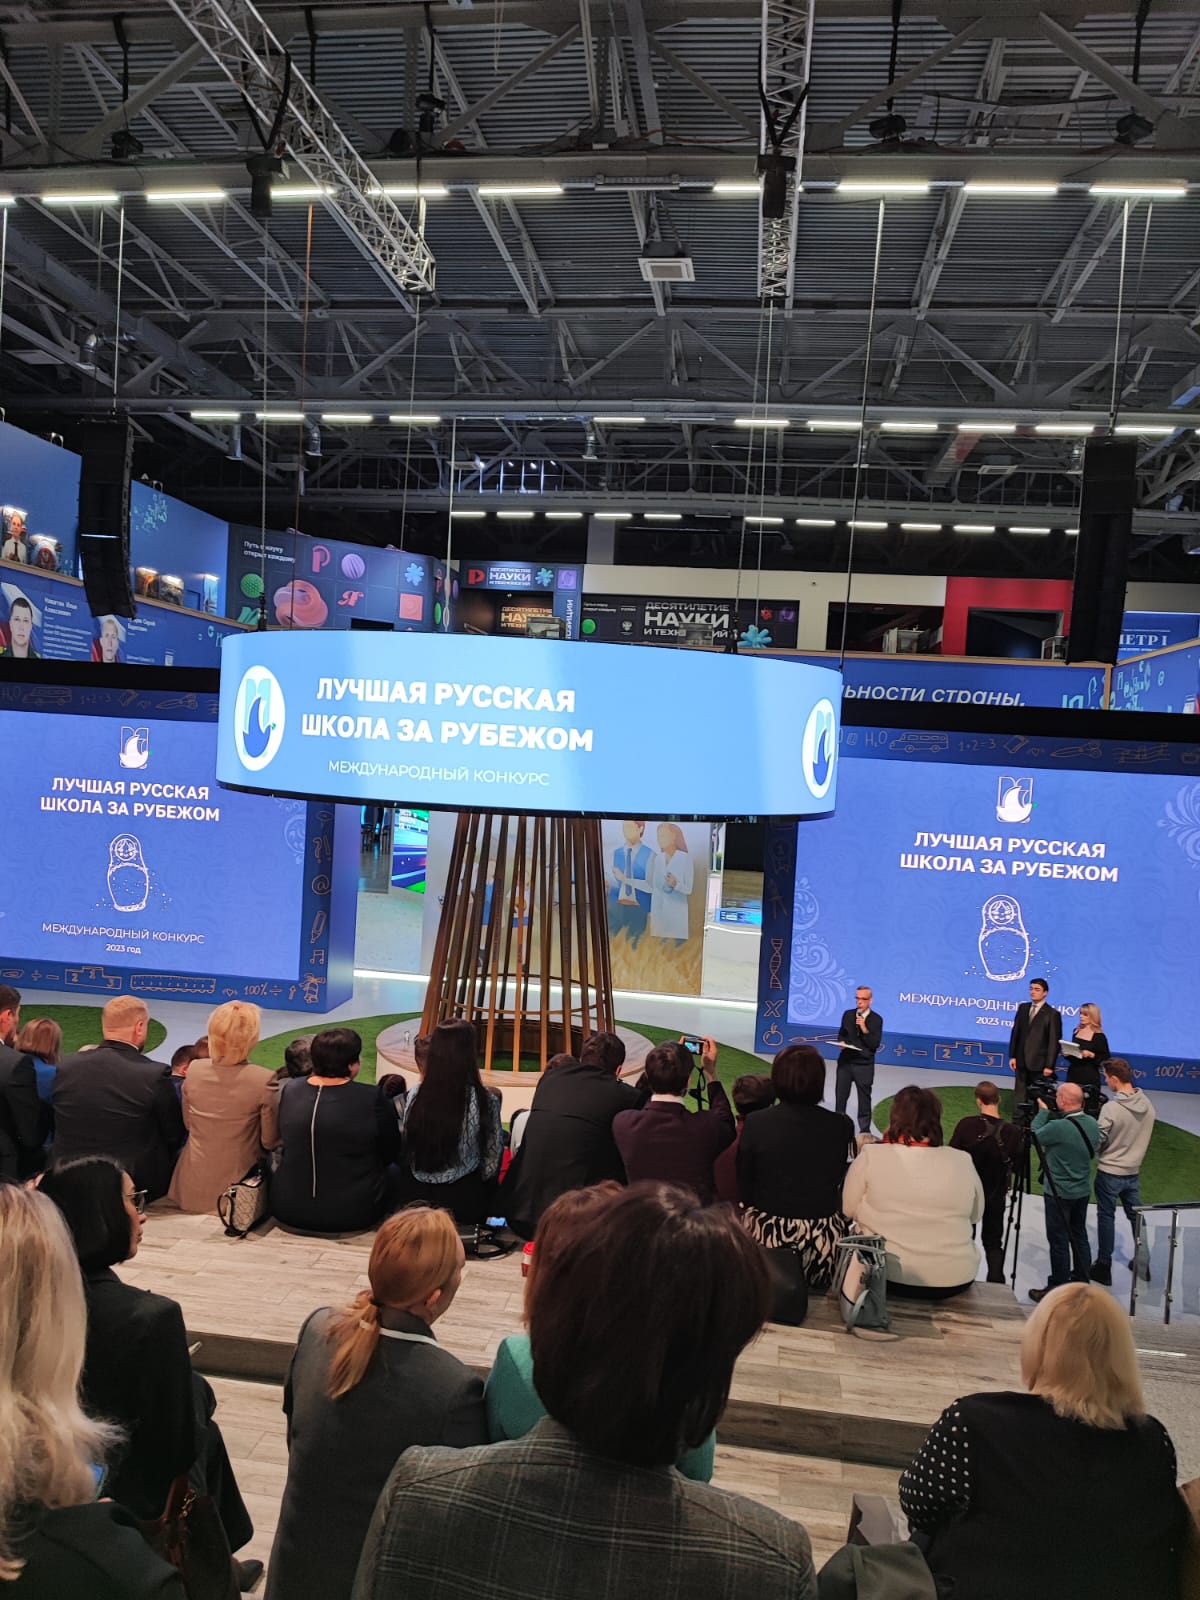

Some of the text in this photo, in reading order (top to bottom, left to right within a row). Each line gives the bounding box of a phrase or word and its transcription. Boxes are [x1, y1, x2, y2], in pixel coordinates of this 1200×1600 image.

[490, 572, 531, 582] НАУКИ
[646, 602, 730, 612] ДЕСЯТИЛЕТИЕ
[644, 612, 730, 628] НАУКИ
[316, 677, 576, 713] ЛУЧШАЯ РУССКАЯ
[842, 685, 926, 702] ьности
[302, 714, 594, 752] ШКОЛА ЗА РУБЕЖОМ
[328, 760, 550, 786] МЕЖДУНАРОДНЫЙ КОНКУРС
[52, 777, 210, 800] ЛУЧШАЯ РУССКАЯ
[40, 796, 220, 822] ШКОЛА ЗА РУБЕЖОМ
[914, 831, 1106, 858] ЛУЧШАЯ РУССКАЯ
[900, 852, 1119, 883] ШКОЛА ЗА РУБЕЖОМ
[42, 922, 205, 944] МЕЖДУНАРОДНЫЙ КОНКУРС
[106, 943, 142, 955] 2023 год
[244, 982, 268, 996] 100%
[900, 993, 1026, 1012] МЕЖДУНАРОДНЫ
[976, 1016, 1000, 1026] 2023
[1154, 1062, 1184, 1078] 100%
